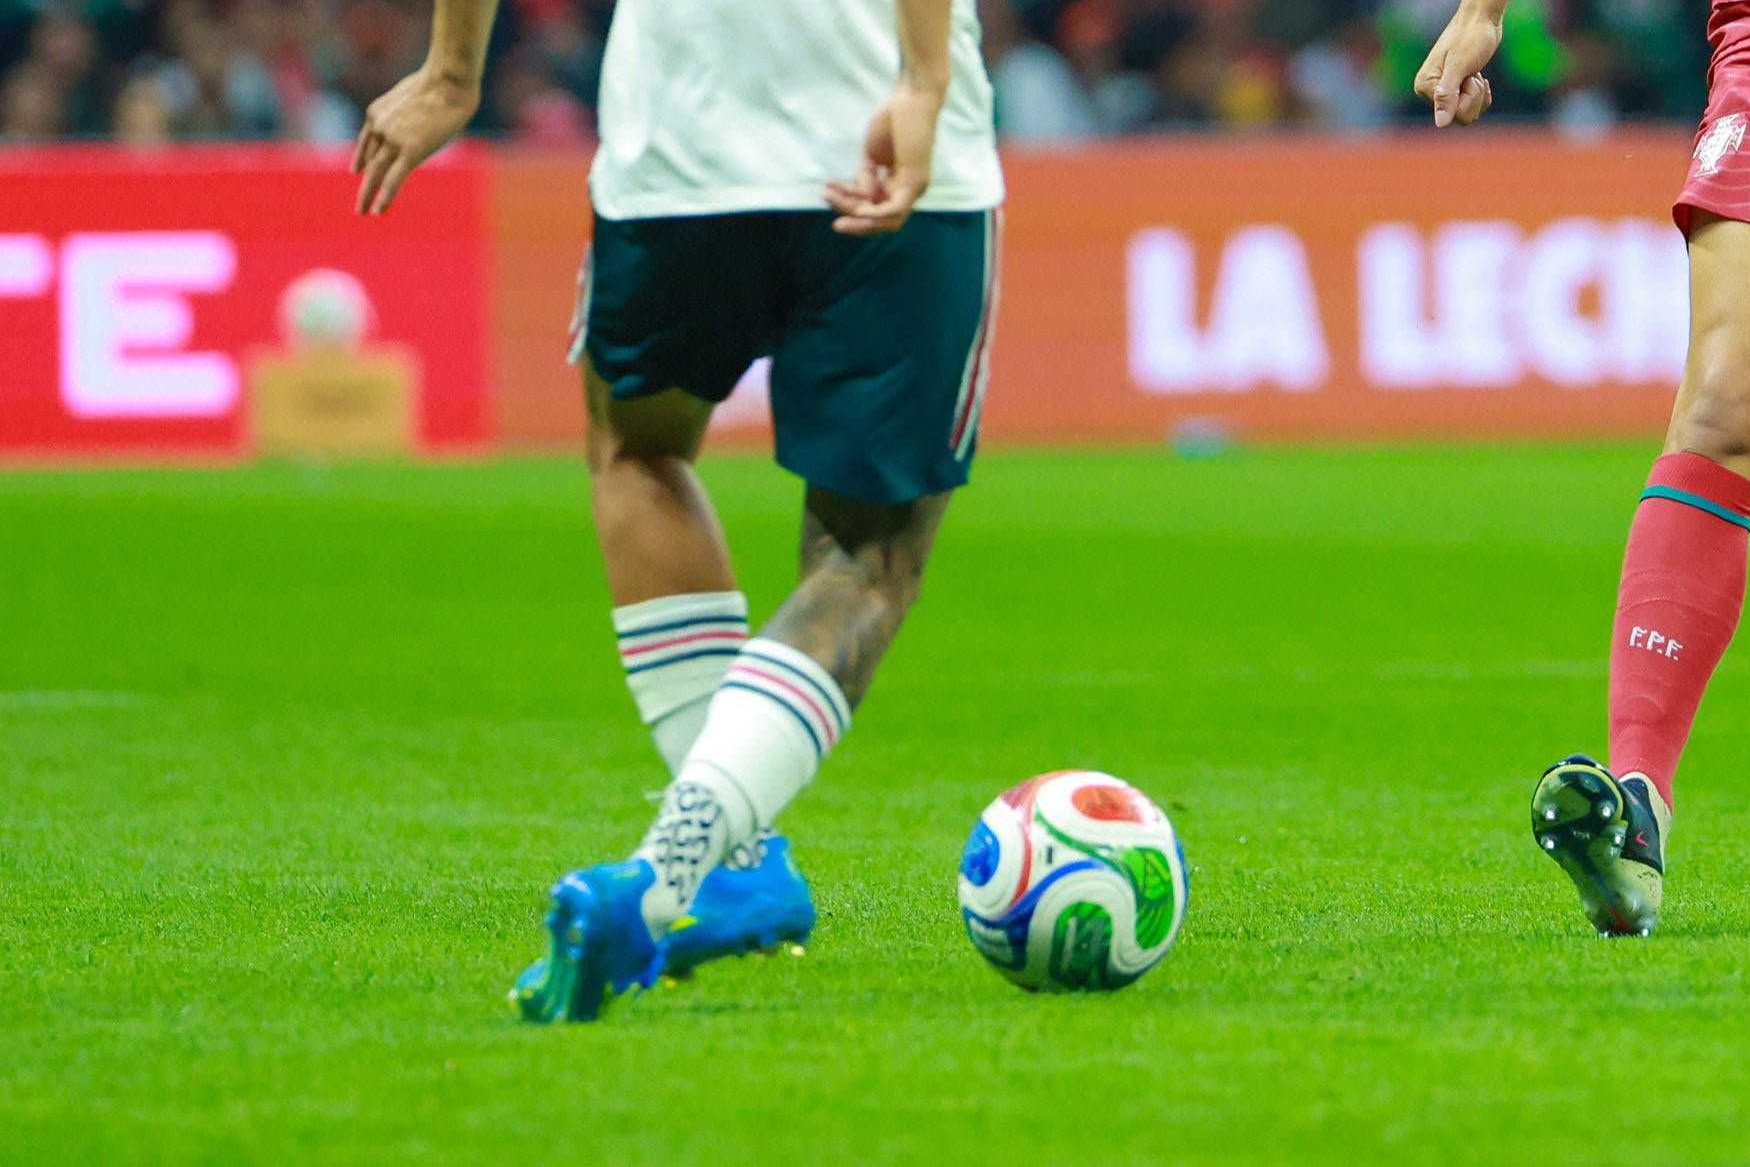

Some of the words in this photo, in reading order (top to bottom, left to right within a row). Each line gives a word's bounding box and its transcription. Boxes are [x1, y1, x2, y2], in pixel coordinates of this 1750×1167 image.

[1124, 225, 1332, 394] LA
[1356, 216, 1690, 387] LECH
[1629, 625, 1684, 662] F.P.F.
